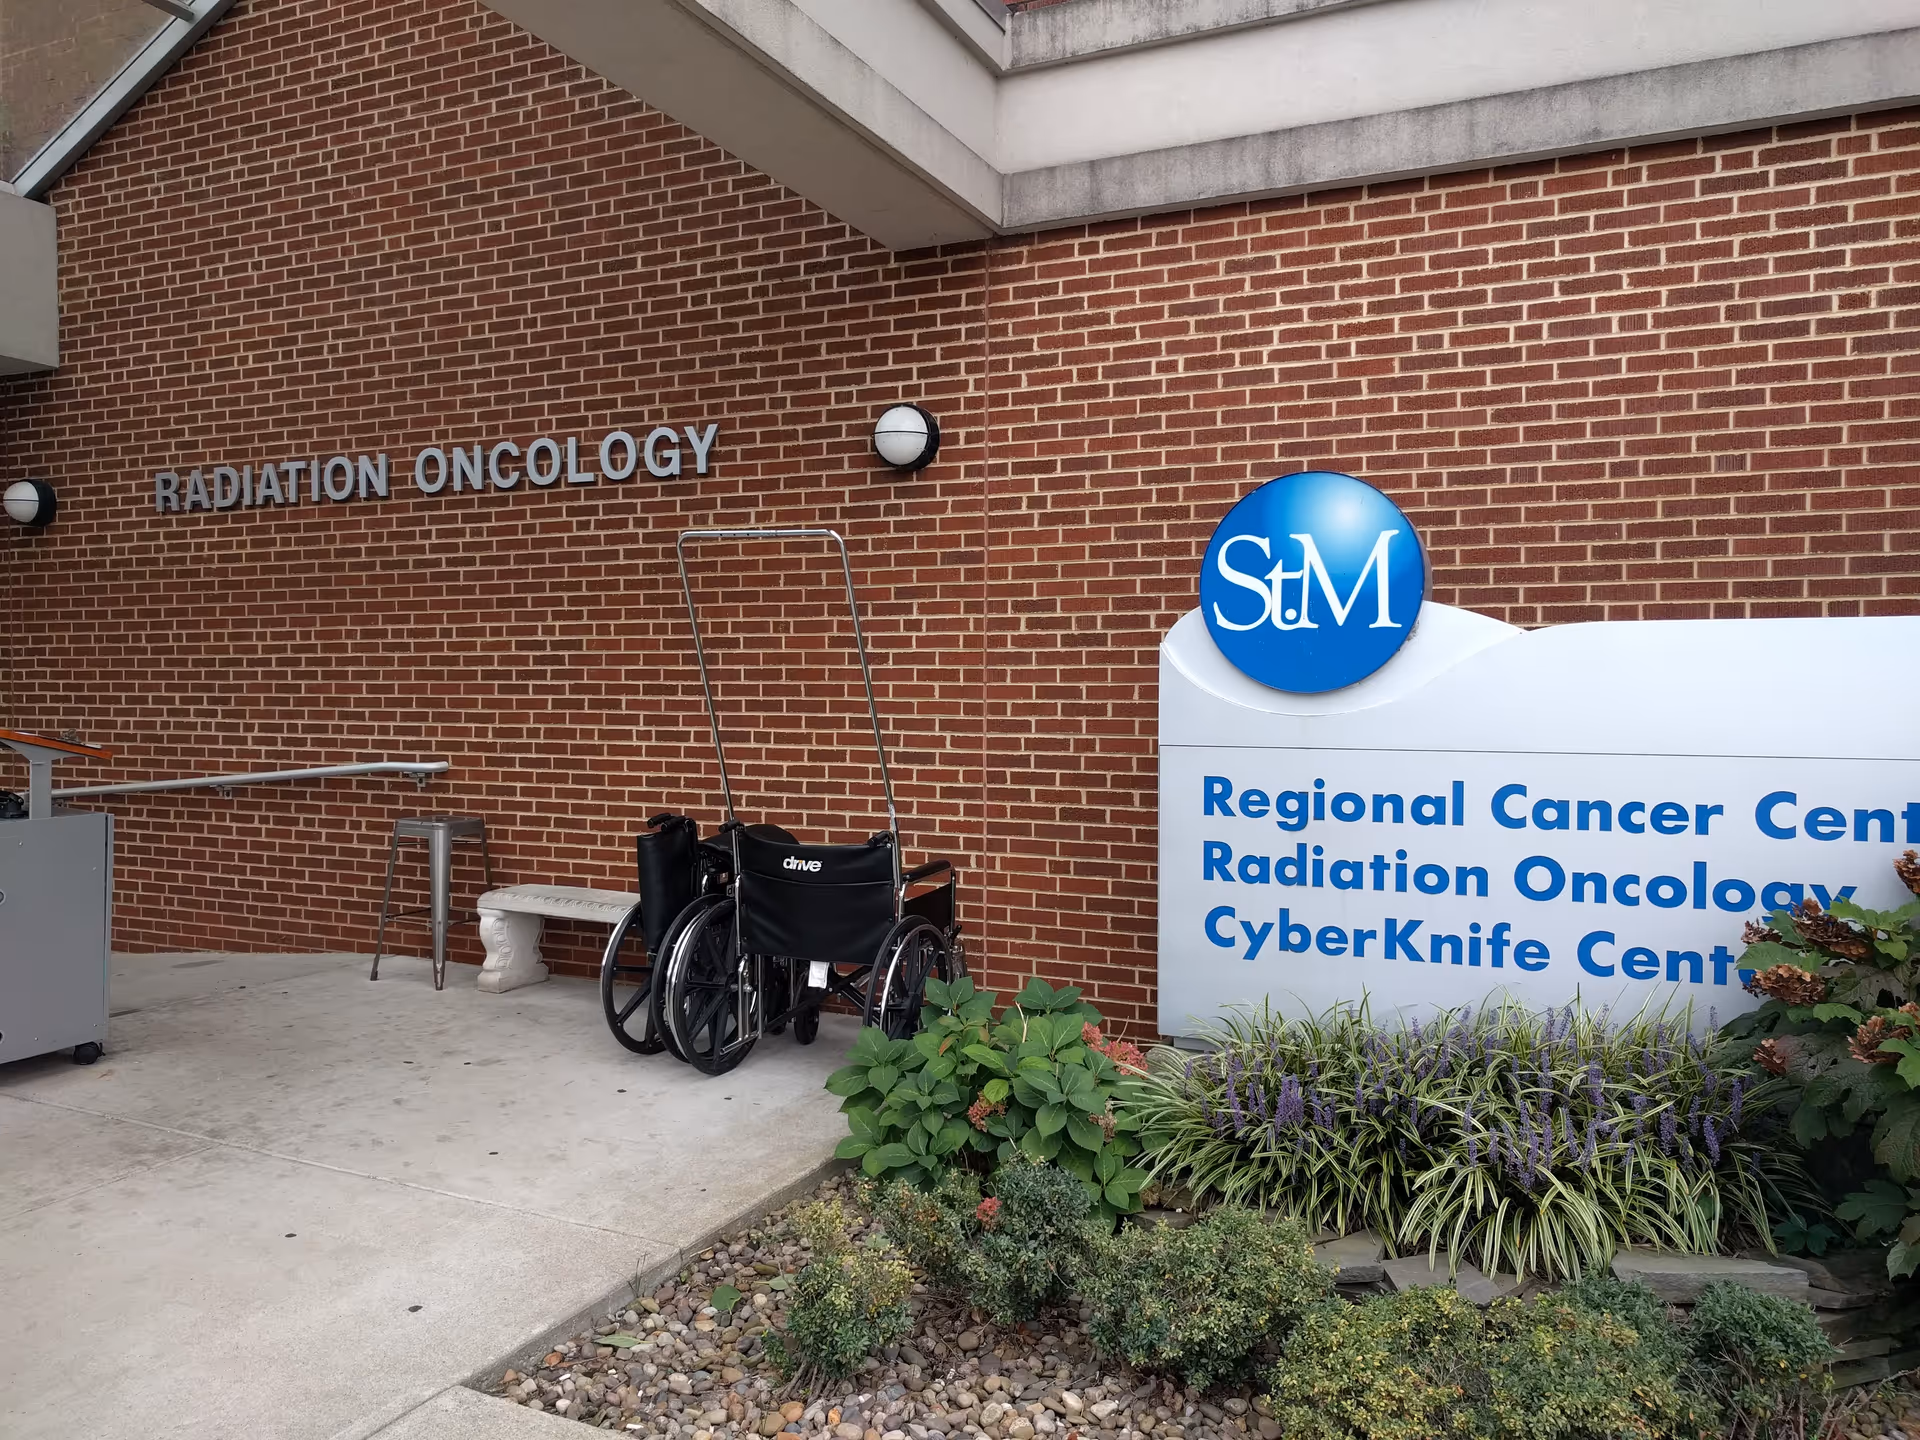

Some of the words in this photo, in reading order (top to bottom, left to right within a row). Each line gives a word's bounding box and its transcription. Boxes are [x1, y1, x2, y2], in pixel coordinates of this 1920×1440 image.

[155, 453, 389, 512] RADIATION
[414, 423, 719, 494] ONCOLOGY
[1203, 775, 1464, 831] Regional
[1491, 783, 1724, 836] Cancer
[783, 856, 822, 872] drive
[1203, 840, 1488, 897] Radiation
[1204, 905, 1550, 972] CyberKnife
[1577, 930, 1757, 986] Cent
